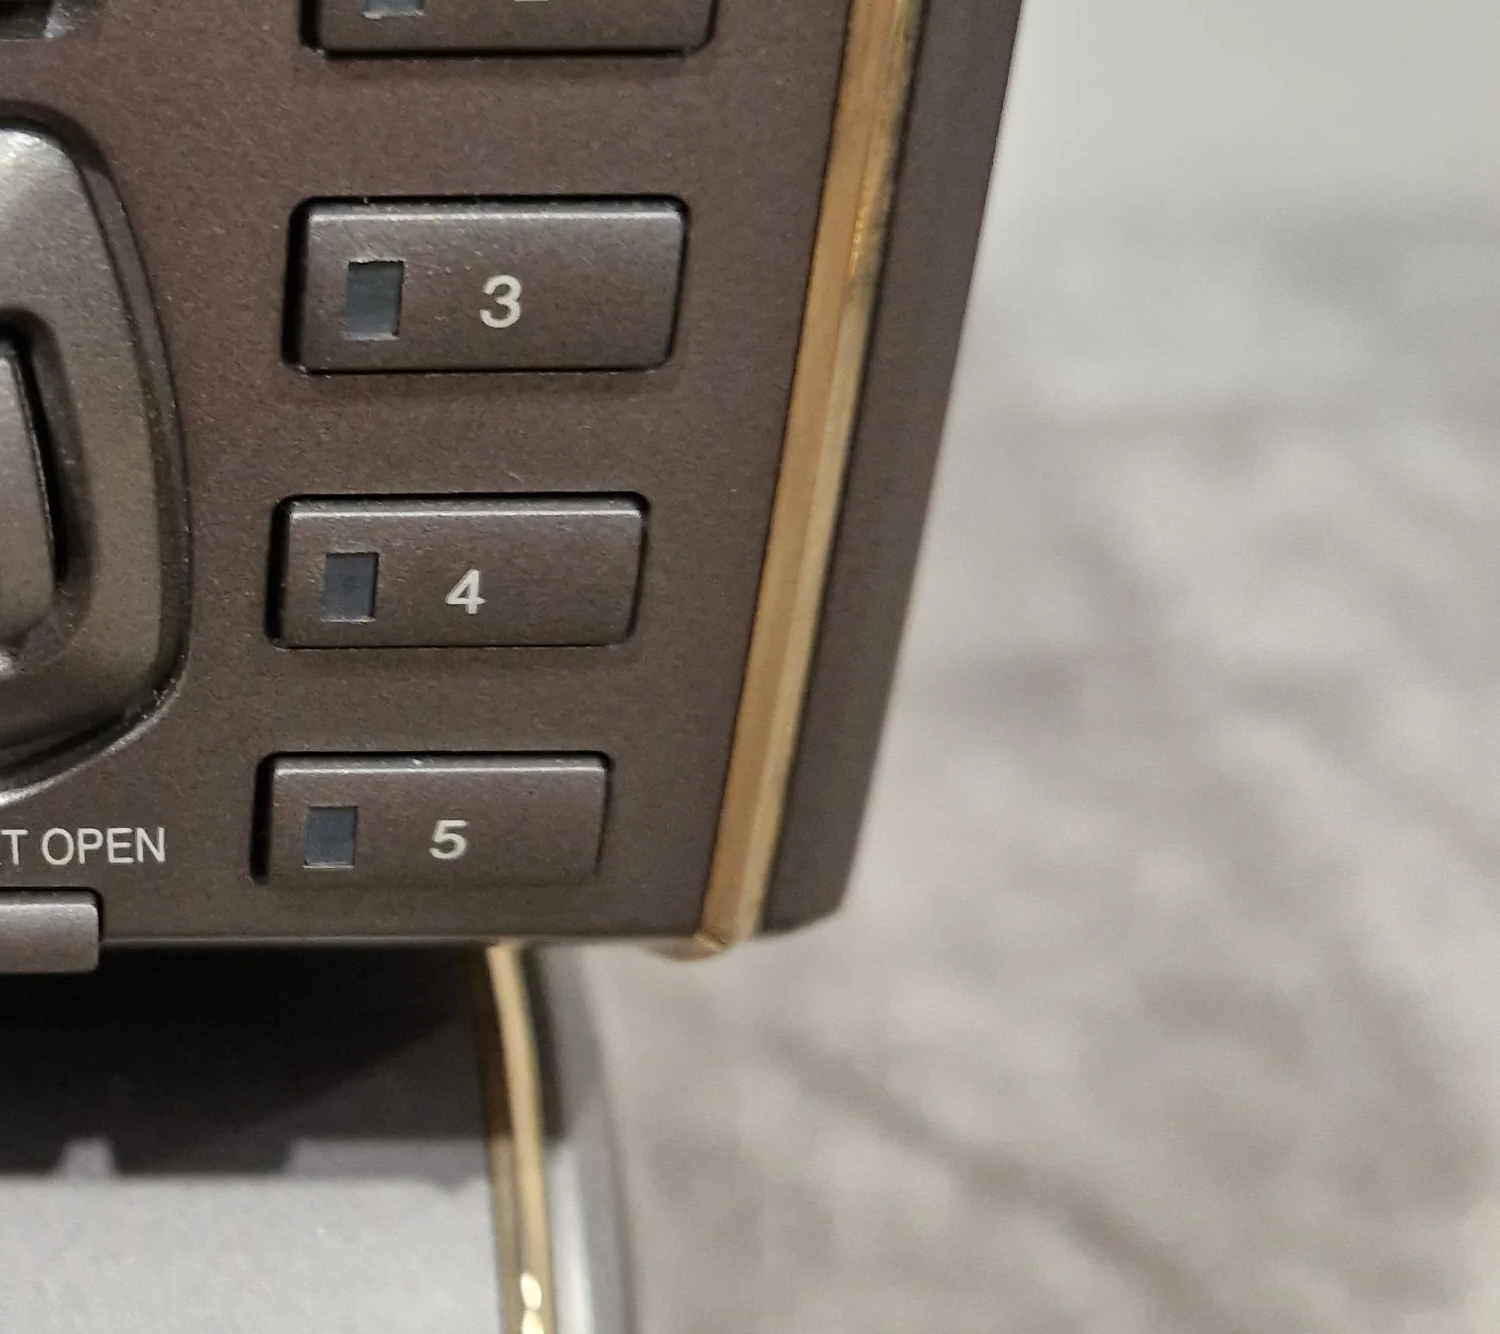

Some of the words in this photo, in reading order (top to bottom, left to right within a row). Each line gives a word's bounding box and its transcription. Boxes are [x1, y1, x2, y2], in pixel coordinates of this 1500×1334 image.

[479, 274, 523, 329] 3
[444, 568, 486, 616] 4
[40, 826, 167, 865] OPEN
[428, 819, 469, 861] 5
